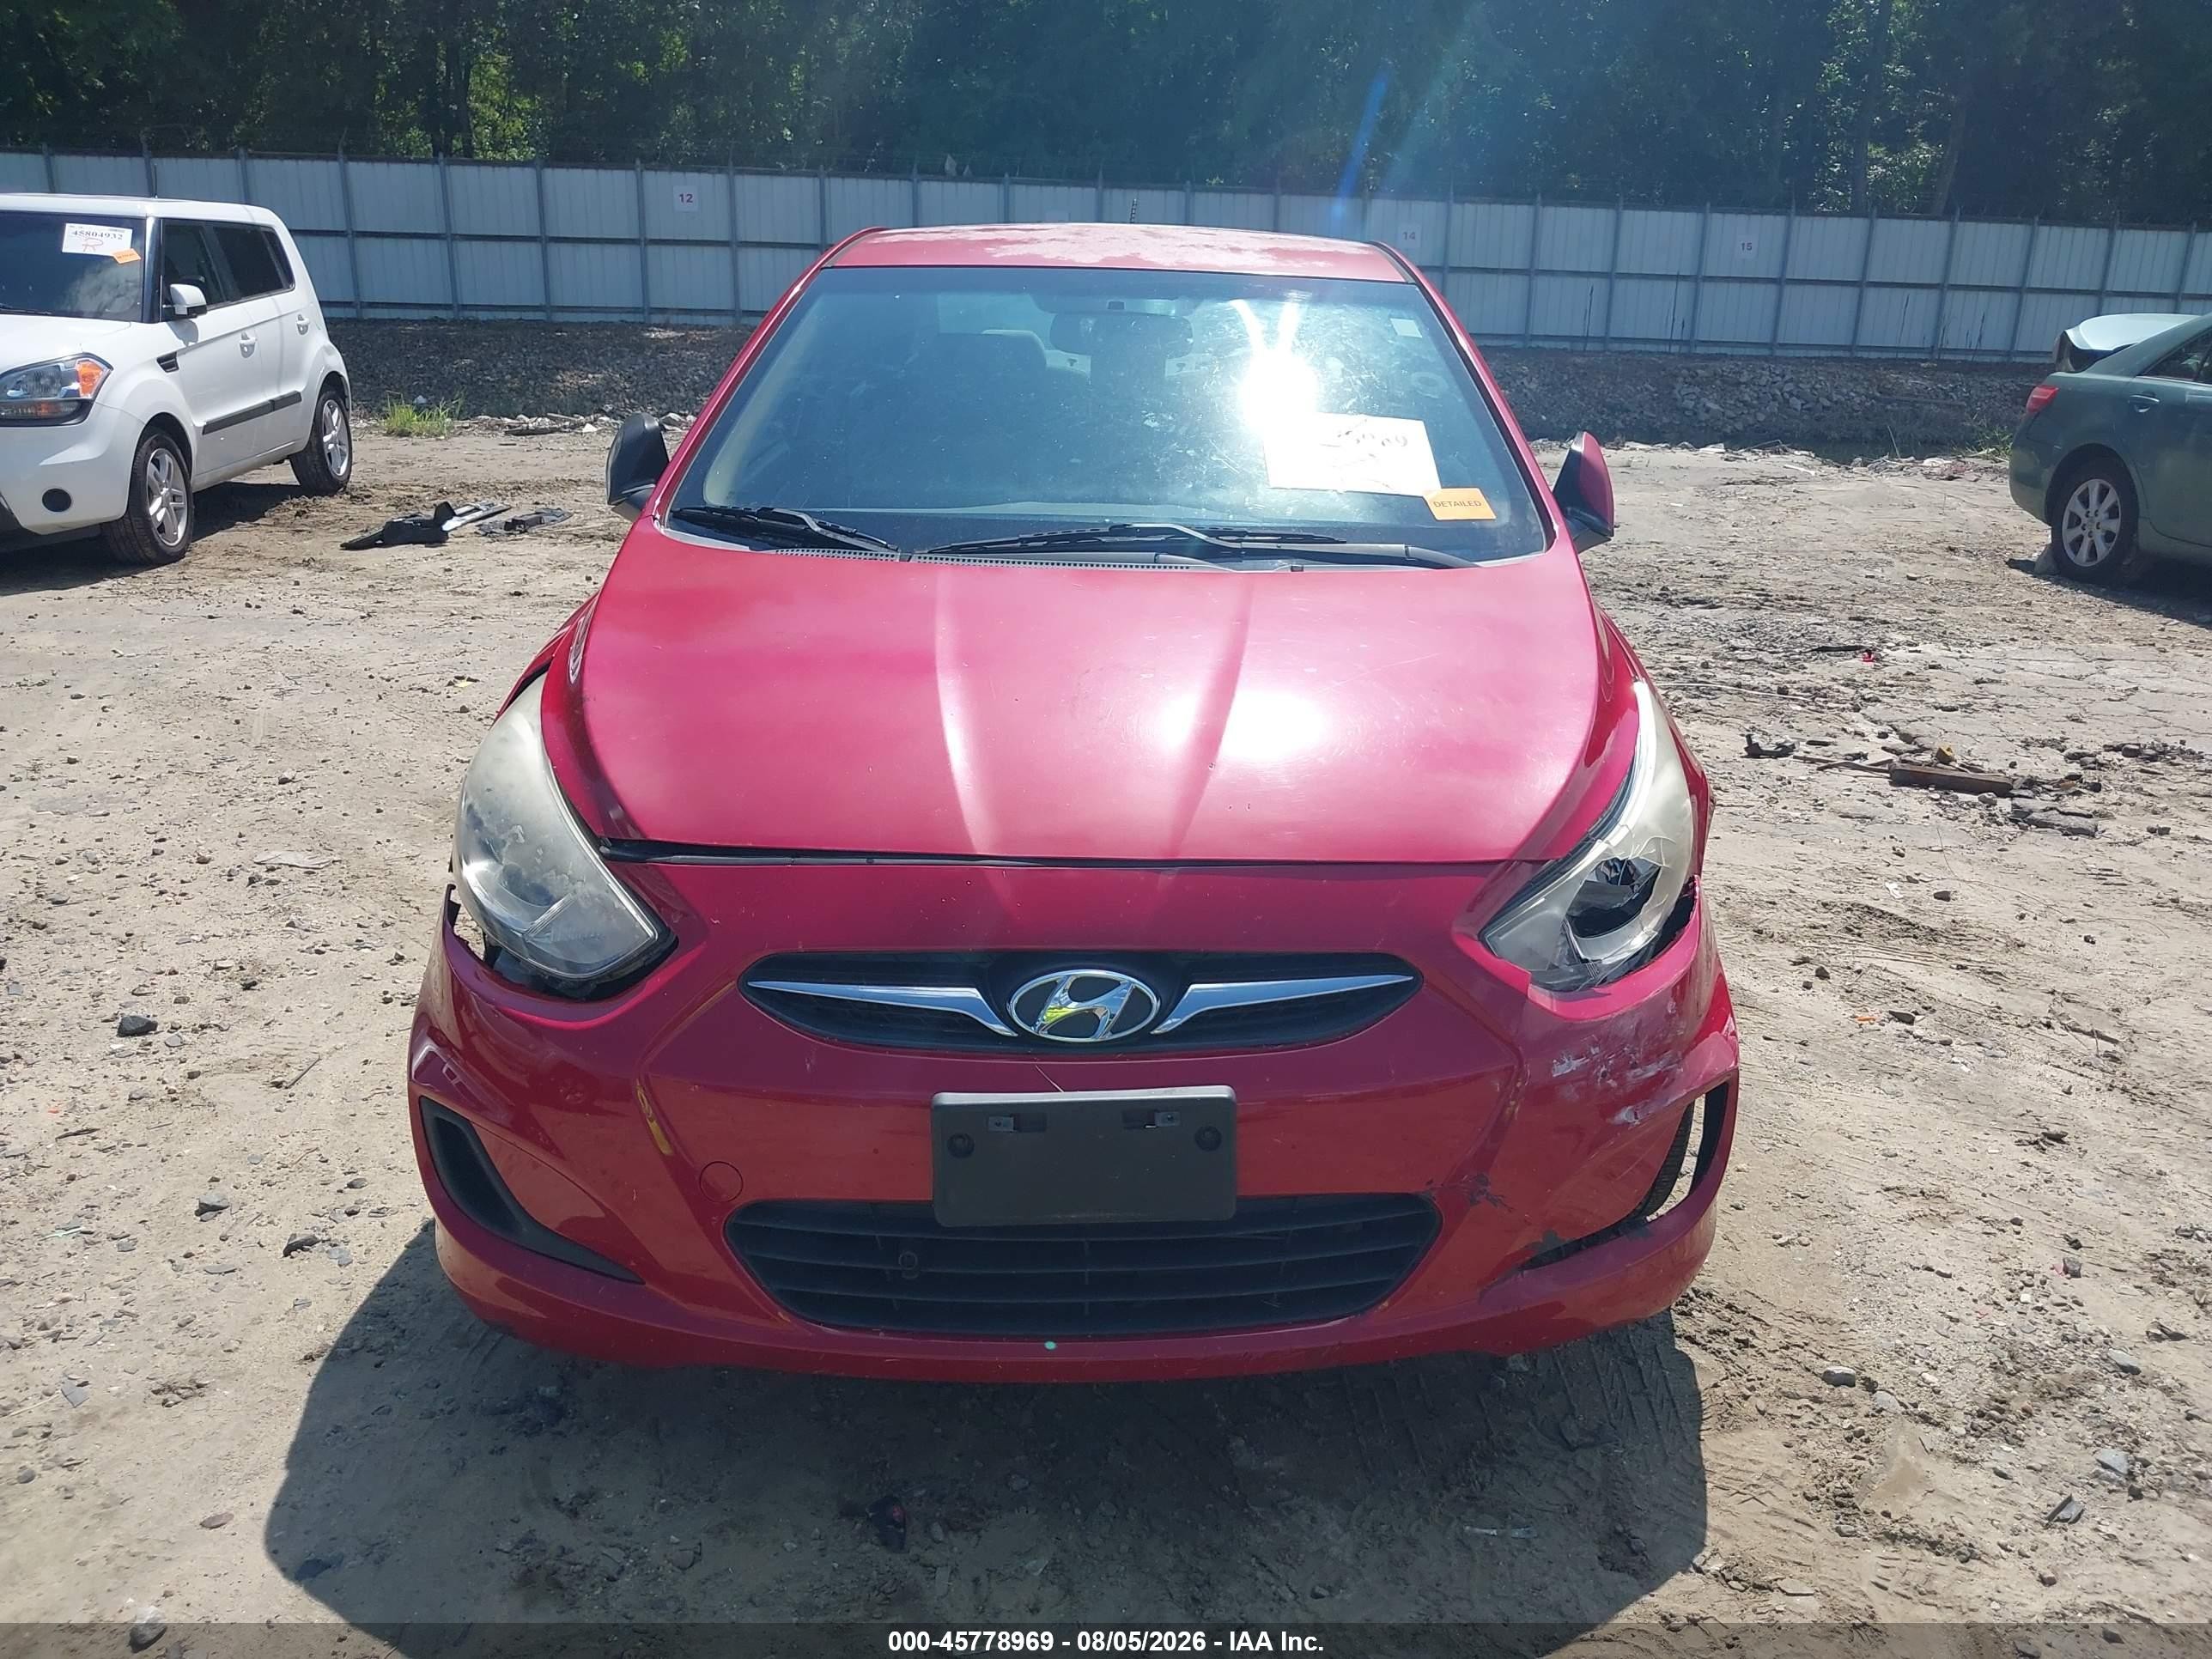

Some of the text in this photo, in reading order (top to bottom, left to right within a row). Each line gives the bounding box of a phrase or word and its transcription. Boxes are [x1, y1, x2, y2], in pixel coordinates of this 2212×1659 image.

[679, 193, 694, 204] 12
[1402, 231, 1416, 240] 14
[1741, 242, 1753, 251] 15
[1432, 500, 1482, 508] DETAILED
